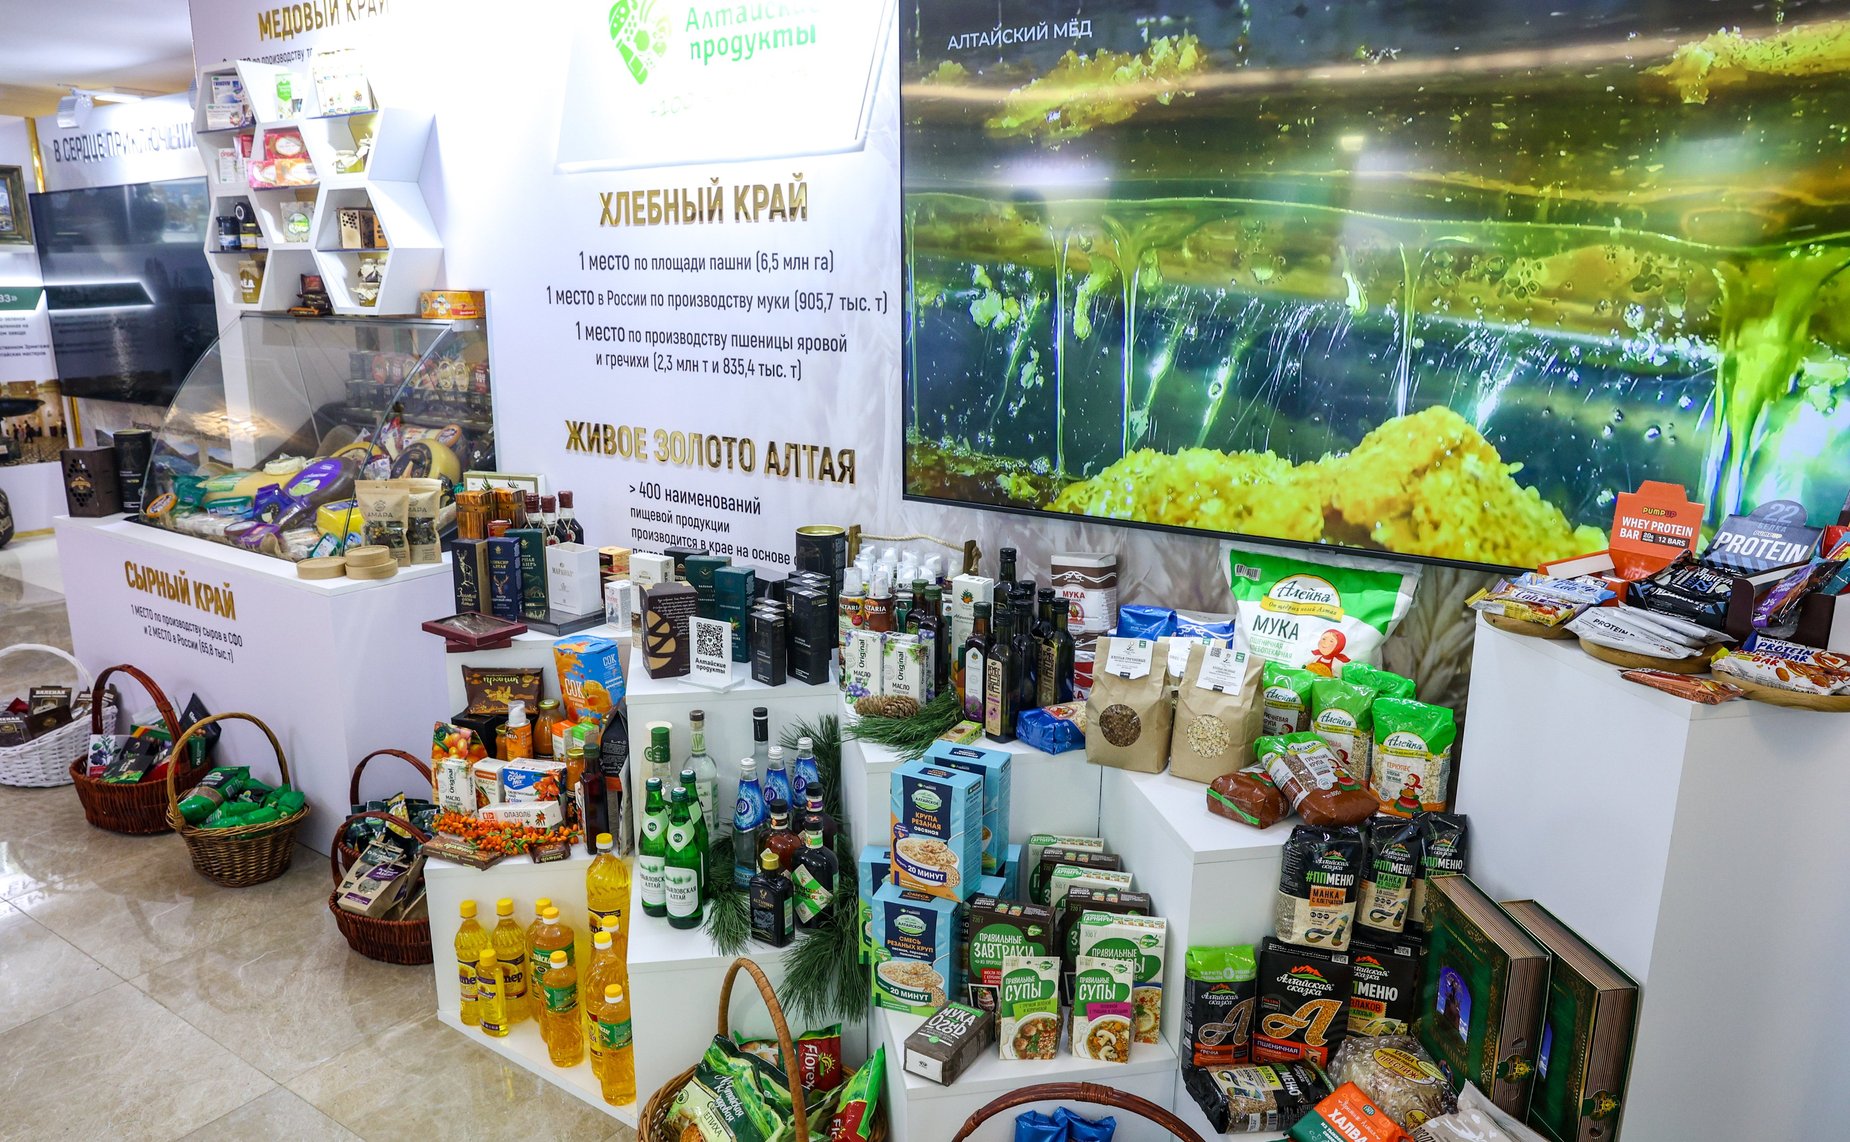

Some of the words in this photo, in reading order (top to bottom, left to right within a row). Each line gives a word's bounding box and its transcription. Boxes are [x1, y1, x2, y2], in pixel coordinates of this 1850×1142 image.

[947, 21, 1049, 50] АЛТАЙСКИЙ
[1053, 19, 1092, 39] МЁД
[690, 24, 816, 66] продукты
[53, 139, 61, 162] В
[62, 133, 105, 162] СЕРДЦЕ
[599, 176, 724, 228] ХЛЕБНЫЙ
[733, 172, 808, 223] КРАЙ
[579, 251, 585, 271] 1
[589, 254, 630, 271] место
[634, 257, 648, 271] по
[651, 257, 706, 273] площади
[710, 256, 752, 271] пашни
[756, 250, 779, 273] (6,5
[783, 256, 809, 271] млн
[814, 250, 834, 273] га)
[546, 285, 552, 304] 1
[556, 290, 595, 305] место
[598, 293, 604, 305] в
[607, 290, 647, 306] России
[650, 294, 664, 307] по
[668, 294, 753, 312] производству
[757, 295, 790, 313] муки
[794, 289, 834, 313] (905,7
[840, 296, 871, 312] тыс.
[875, 290, 888, 315] т)
[575, 321, 581, 340] 1
[585, 325, 625, 342] место
[628, 330, 642, 342] по
[645, 331, 728, 351] производству
[731, 333, 793, 352] пшеницы
[797, 333, 847, 354] яровой
[596, 353, 602, 365] и
[605, 354, 649, 369] гречихи
[653, 351, 673, 373] (2,3
[676, 359, 699, 373] млн
[702, 360, 709, 373] т
[712, 361, 719, 373] и
[723, 357, 755, 378] 835,4
[758, 363, 787, 378] тыс.
[790, 359, 802, 381] т)
[565, 419, 648, 461] ЖИВОЕ
[653, 428, 756, 474] ЗОЛОТО
[764, 441, 856, 486] АЛТАЯ
[639, 481, 661, 500] 400
[665, 487, 761, 515] наименований
[630, 507, 673, 524] пищевой
[675, 514, 730, 534] продукции
[1763, 503, 1800, 524] 22
[1622, 516, 1650, 530] WHEY
[1651, 520, 1694, 537] PROTEIN
[631, 528, 698, 550] производится
[700, 539, 707, 550] в
[709, 541, 734, 556] крае
[736, 547, 749, 558] на
[752, 549, 791, 566] основе
[1619, 527, 1640, 540] BAR
[1667, 538, 1686, 547] BARS
[1712, 531, 1809, 563] PROTEIN
[124, 560, 191, 606] СЫРНЫЙ
[193, 582, 237, 621] КРАЙ
[1062, 590, 1086, 599] МУКА
[1277, 580, 1331, 603] Алейка
[135, 605, 154, 620] МЕСТО
[154, 612, 162, 622] по
[162, 615, 202, 637] производству
[202, 626, 223, 641] сыров
[223, 633, 228, 643] в
[227, 632, 243, 647] СФО
[1252, 615, 1299, 641] МУКА
[1593, 617, 1629, 636] PROTEIN
[144, 626, 148, 635] и
[148, 625, 152, 636] 2
[152, 627, 172, 642] МЕСТО
[172, 635, 177, 644] в
[177, 633, 199, 651] России
[199, 639, 214, 656] (65,8
[1757, 641, 1815, 656] PROTEIN
[602, 653, 617, 667] СОК
[565, 678, 585, 699] СОК
[892, 682, 910, 691] МАСЛО
[1320, 712, 1352, 727] Алейка
[1387, 735, 1424, 750] Алейка
[911, 818, 942, 830] РЕЗАНАЯ
[915, 812, 938, 823] КРУПА
[907, 865, 917, 873] 20
[917, 868, 944, 880] МИНУТ
[1306, 870, 1354, 887] #ППМЕНЮ
[1312, 888, 1340, 899] МАНКА
[887, 940, 916, 951] РЕЗАНЫХ
[916, 945, 934, 953] КРУП
[898, 936, 922, 945] СМЕСЬ
[979, 932, 1022, 944] ПРАВИЛЬНЫЕ
[974, 942, 1034, 959] ЗАВТРАКИ
[1091, 948, 1138, 958] ПРАВИЛЬНЫЕ
[1005, 975, 1036, 985] ПРАВИЛЬНЫЕ
[1079, 976, 1110, 984] ПРАВИЛЬНЫЕ
[1276, 973, 1334, 992] Алтайская
[890, 987, 899, 995] 20
[900, 990, 929, 1001] МИНУТ
[1005, 981, 1042, 1002] СУПЫ
[1079, 983, 1116, 1001] СУПЫ
[1286, 984, 1323, 997] сказка
[938, 1007, 976, 1027] МУКА
[1257, 1040, 1299, 1054] ПШЕНИЧНАЯ
[1394, 1050, 1414, 1063] ХАЛВА
[803, 1043, 818, 1090] Florex
[1311, 1055, 1317, 1063] 6
[1379, 1055, 1418, 1079] ПРЕСТИЖ
[1328, 1108, 1368, 1142] ХАЛВА
